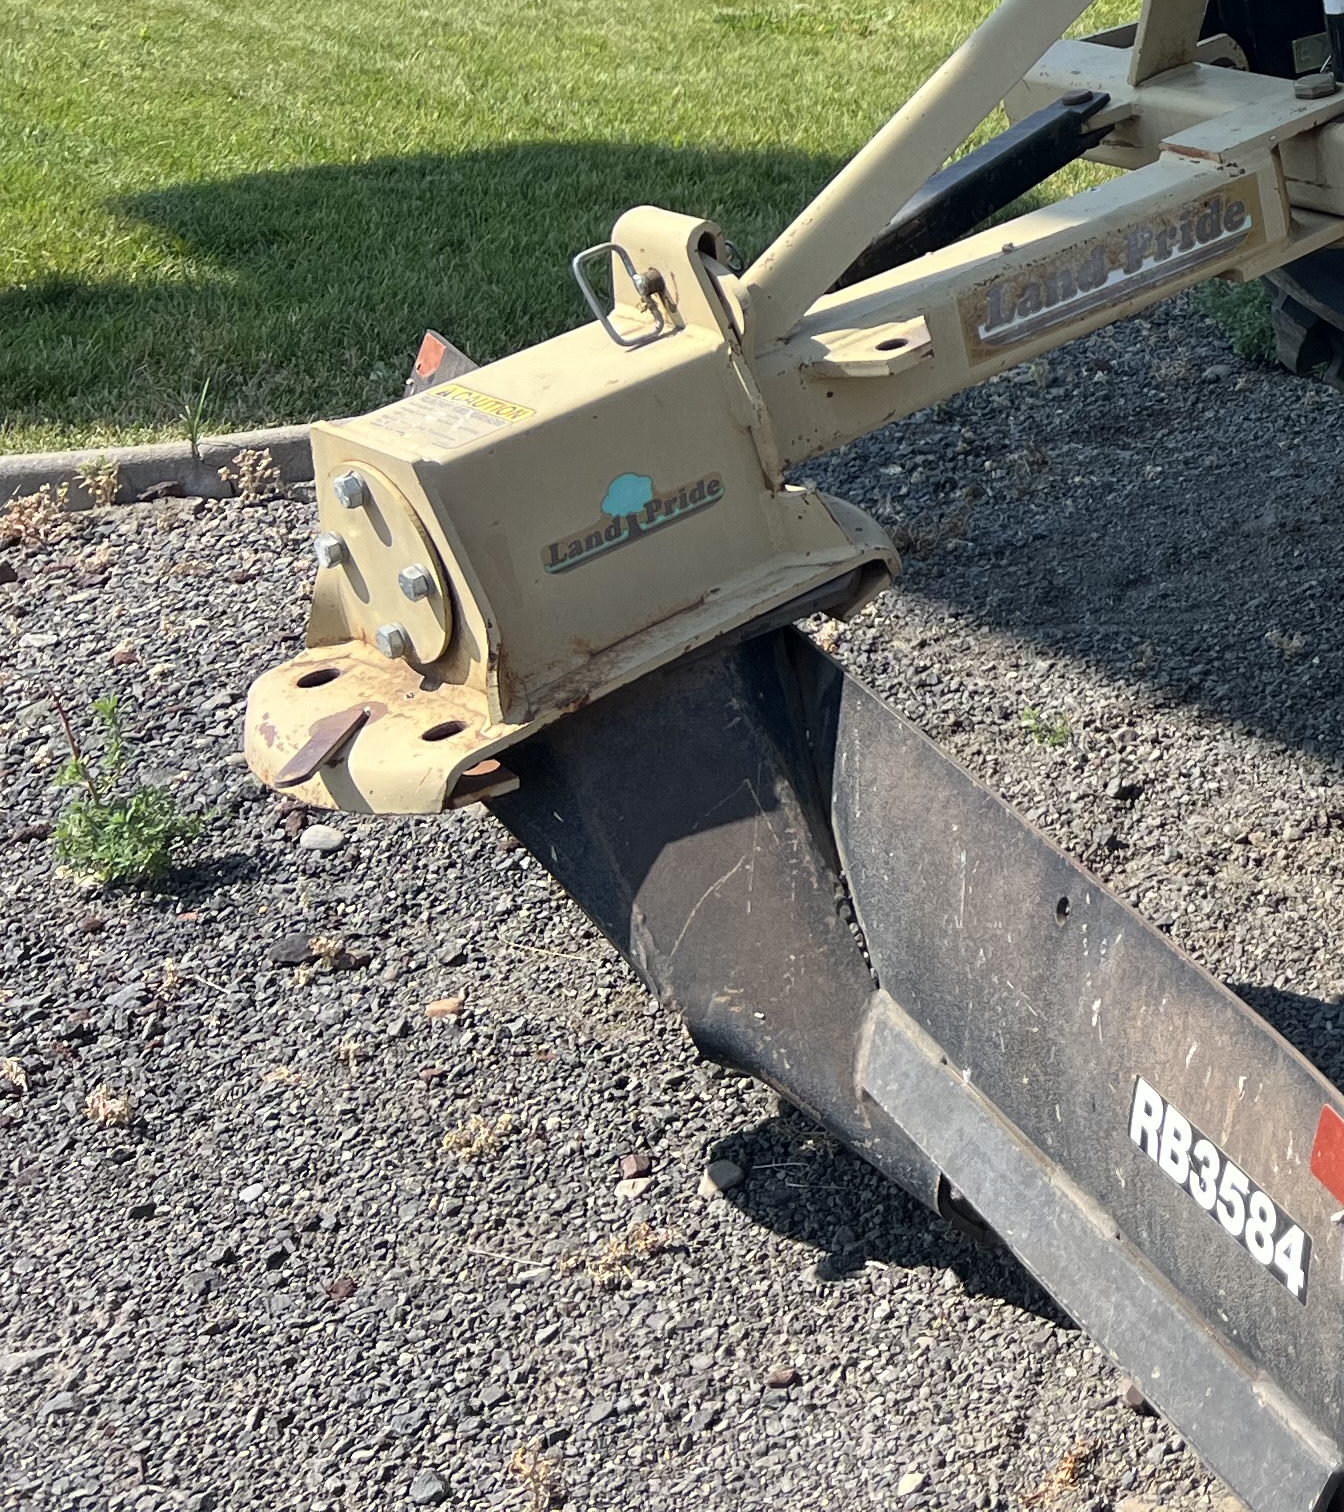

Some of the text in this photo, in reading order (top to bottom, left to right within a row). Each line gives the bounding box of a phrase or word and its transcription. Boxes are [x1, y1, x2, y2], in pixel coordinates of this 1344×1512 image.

[985, 198, 1246, 332] Land Pride
[451, 390, 530, 421] CAUTION
[549, 478, 721, 566] Land Pride
[1130, 1076, 1305, 1297] RB3584
